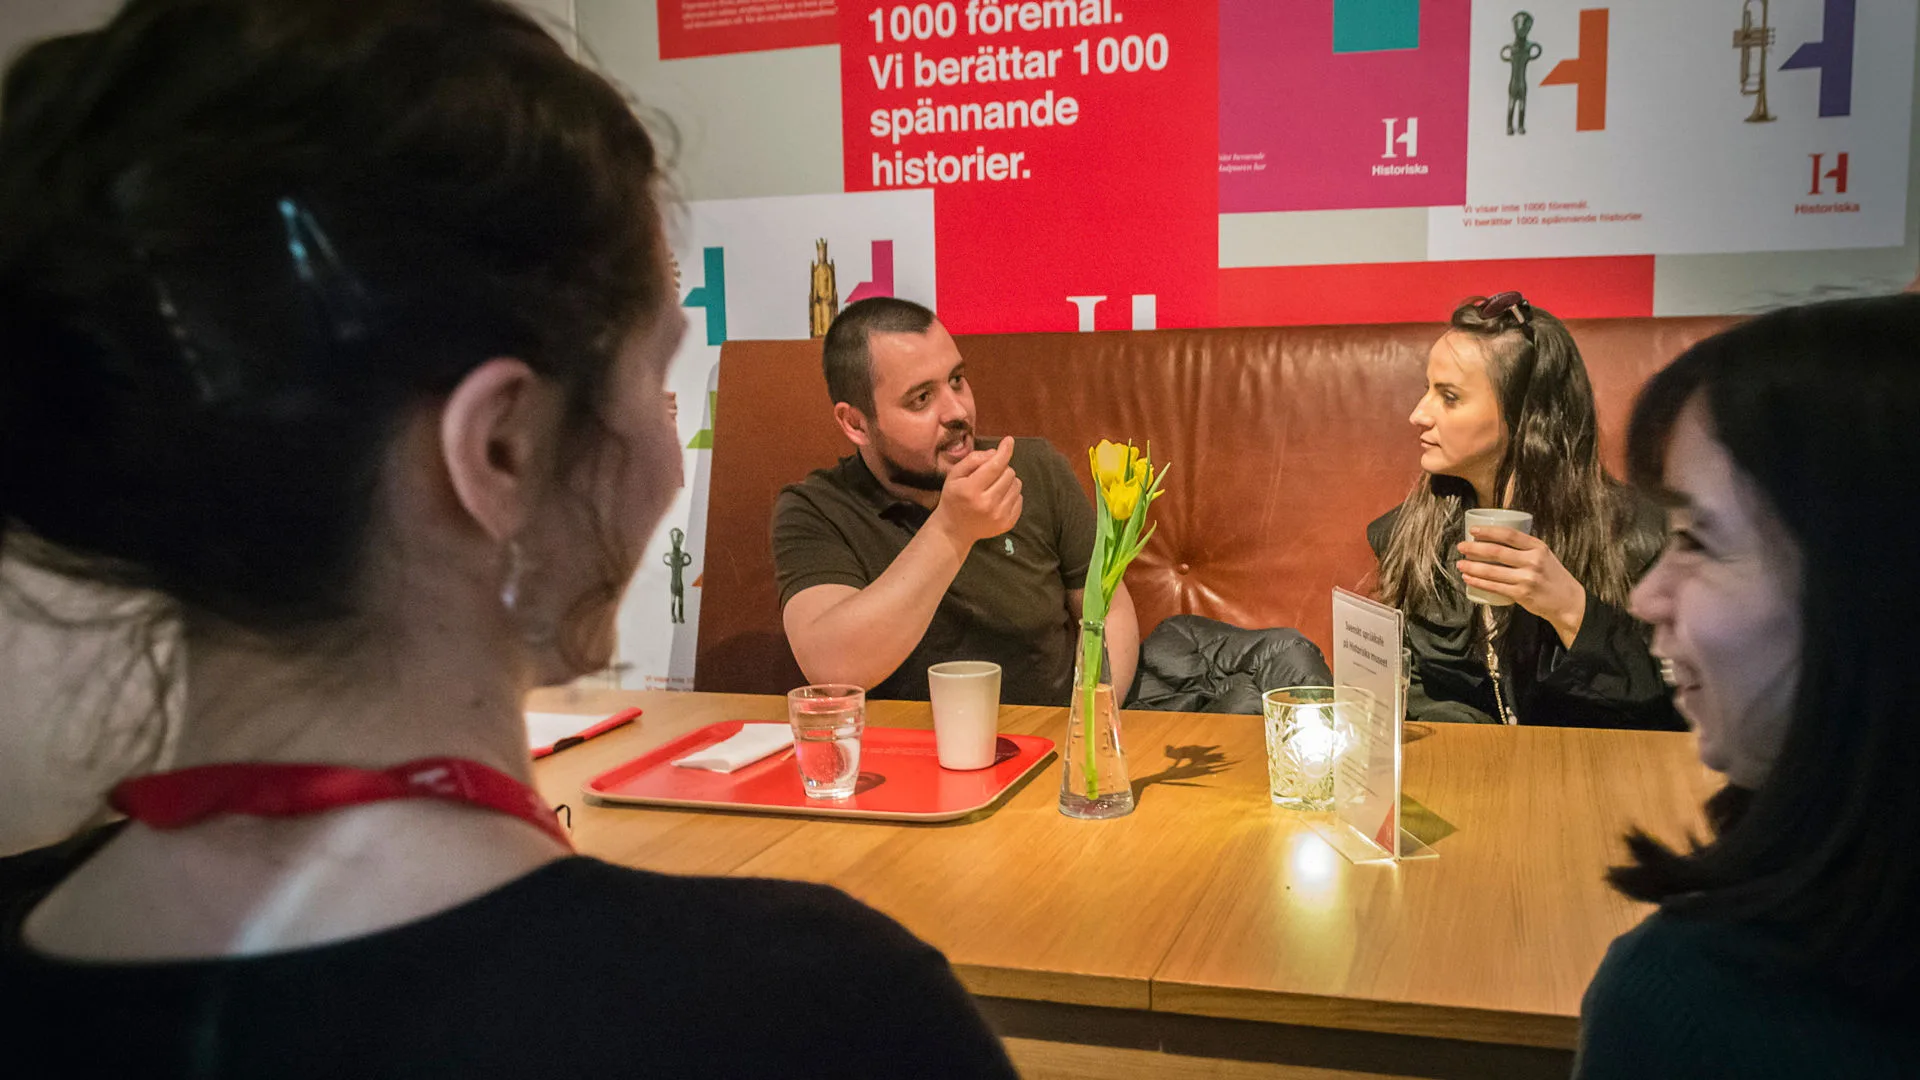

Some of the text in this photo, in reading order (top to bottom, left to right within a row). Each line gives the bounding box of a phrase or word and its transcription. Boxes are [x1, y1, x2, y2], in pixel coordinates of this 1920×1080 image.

[867, 1, 957, 43] 1000
[868, 33, 1169, 90] Vi berättar 1000
[870, 90, 1080, 144] spännande
[872, 146, 1031, 187] historier.
[1371, 163, 1429, 176] Historiska
[1475, 205, 1499, 213] visar
[1502, 204, 1520, 212] inte
[1524, 202, 1546, 211] 1000
[1475, 217, 1513, 226] berättar
[1517, 215, 1539, 225] 1000
[1541, 214, 1597, 226] spännande
[1795, 202, 1860, 214] Historiska
